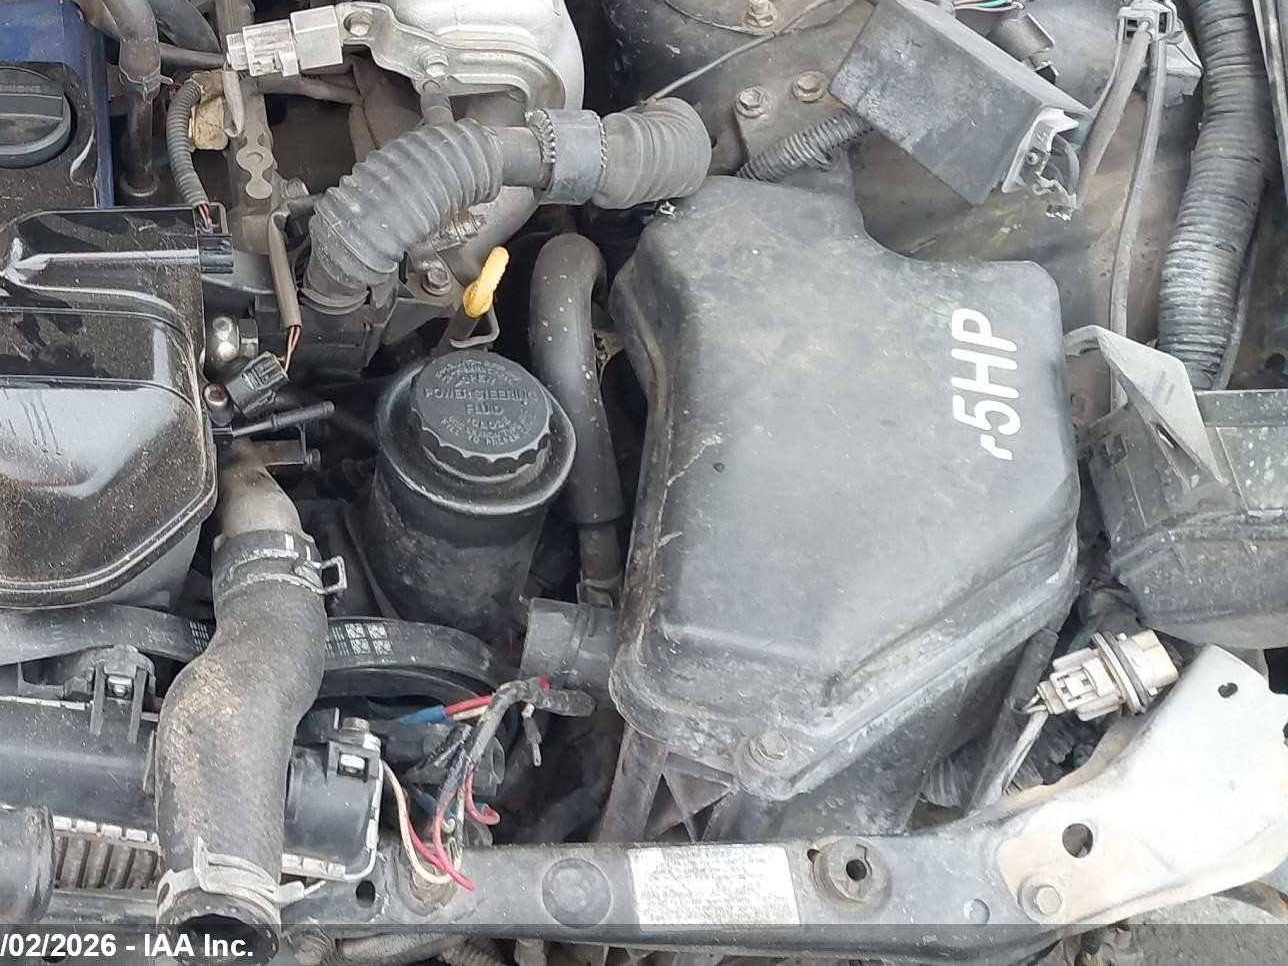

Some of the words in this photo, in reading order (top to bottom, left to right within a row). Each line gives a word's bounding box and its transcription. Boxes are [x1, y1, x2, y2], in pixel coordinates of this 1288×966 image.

[424, 387, 473, 400] POWER
[473, 388, 539, 402] STEERING
[466, 403, 505, 416] FLUID
